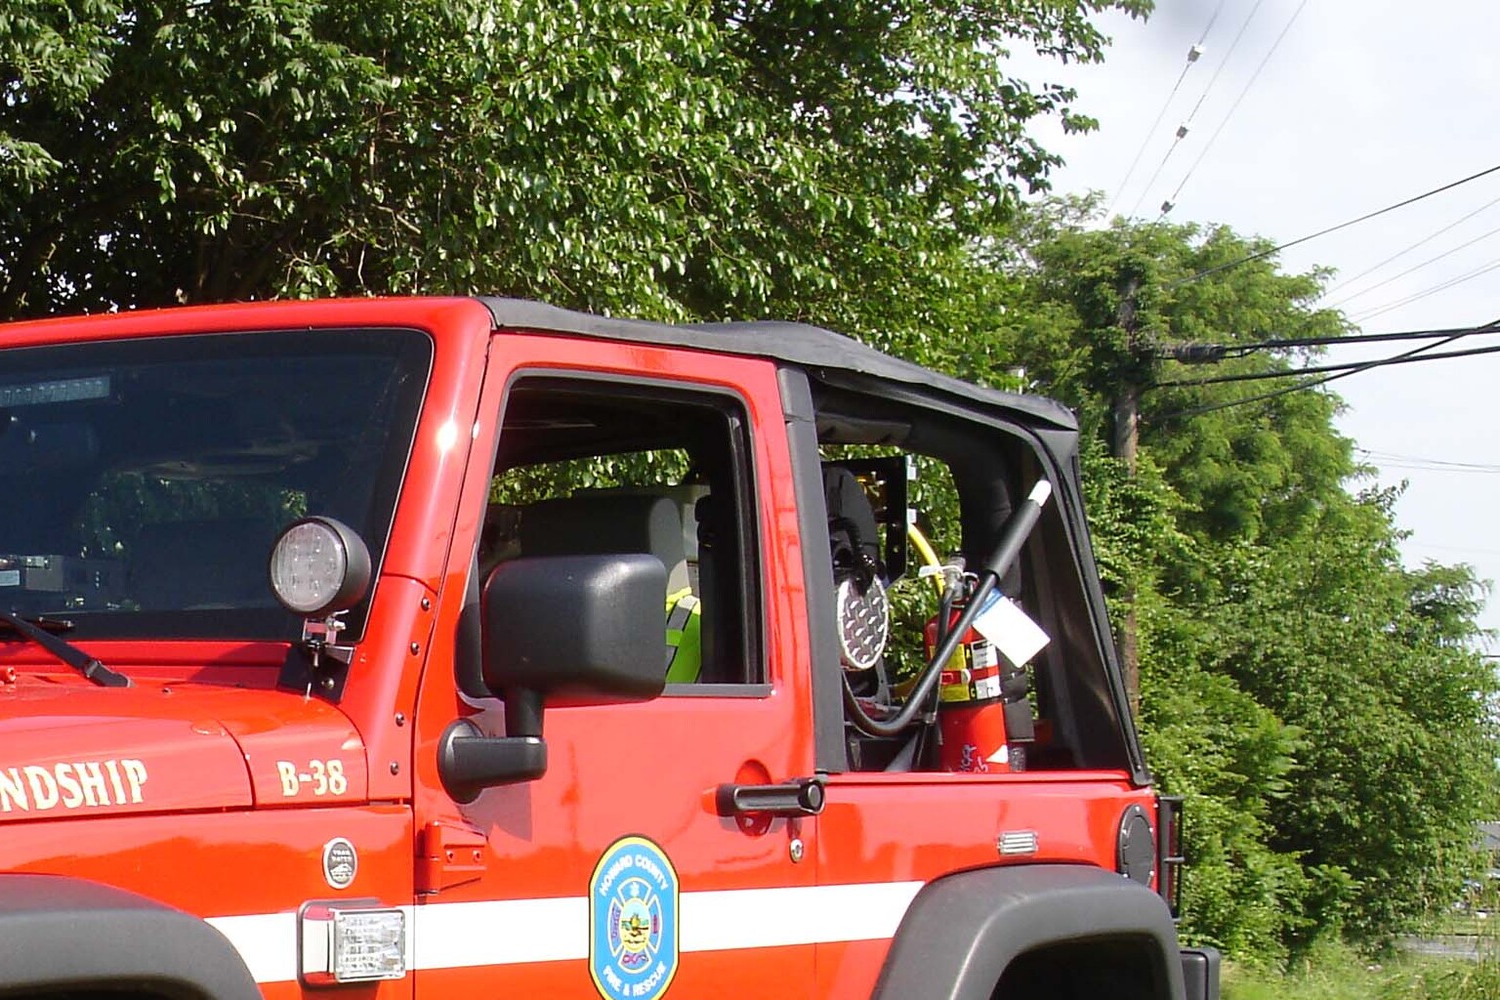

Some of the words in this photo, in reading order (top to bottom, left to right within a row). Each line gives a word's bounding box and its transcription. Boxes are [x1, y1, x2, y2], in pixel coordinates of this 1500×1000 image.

[276, 759, 348, 797] B-38
[599, 854, 633, 897] HOWARD
[635, 854, 669, 891] COUNTY
[602, 964, 623, 992] FIRE
